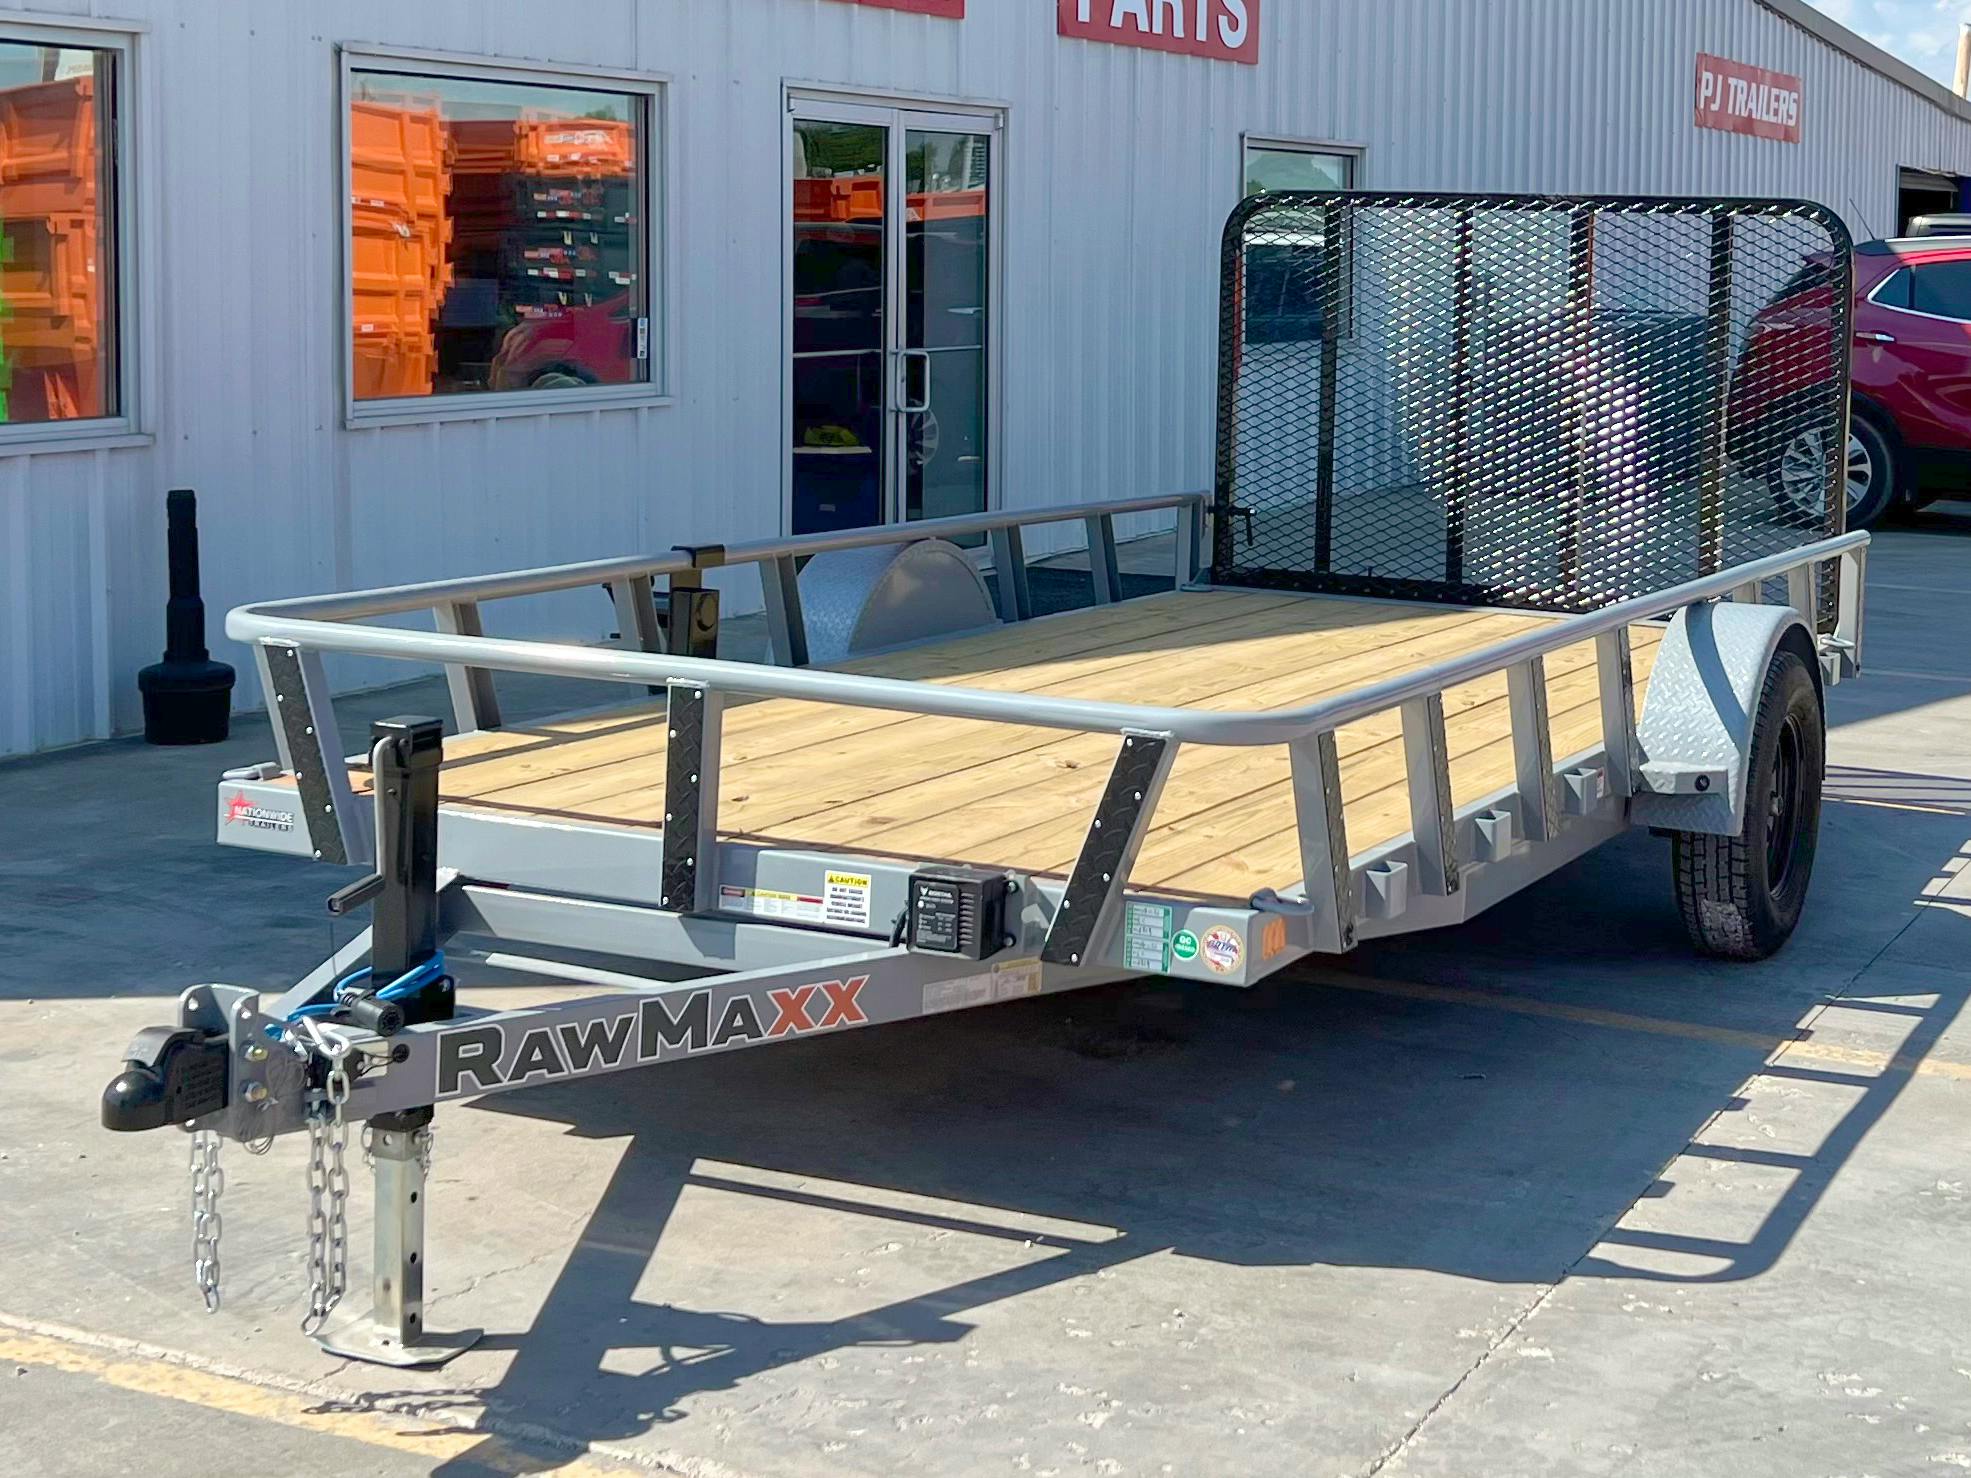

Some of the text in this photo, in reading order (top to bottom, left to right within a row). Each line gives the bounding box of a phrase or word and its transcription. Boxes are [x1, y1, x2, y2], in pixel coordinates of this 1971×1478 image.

[1699, 71, 1799, 127] PJ TRAILERS
[234, 805, 293, 822] NATIONWIDE
[835, 875, 868, 886] CAUTION
